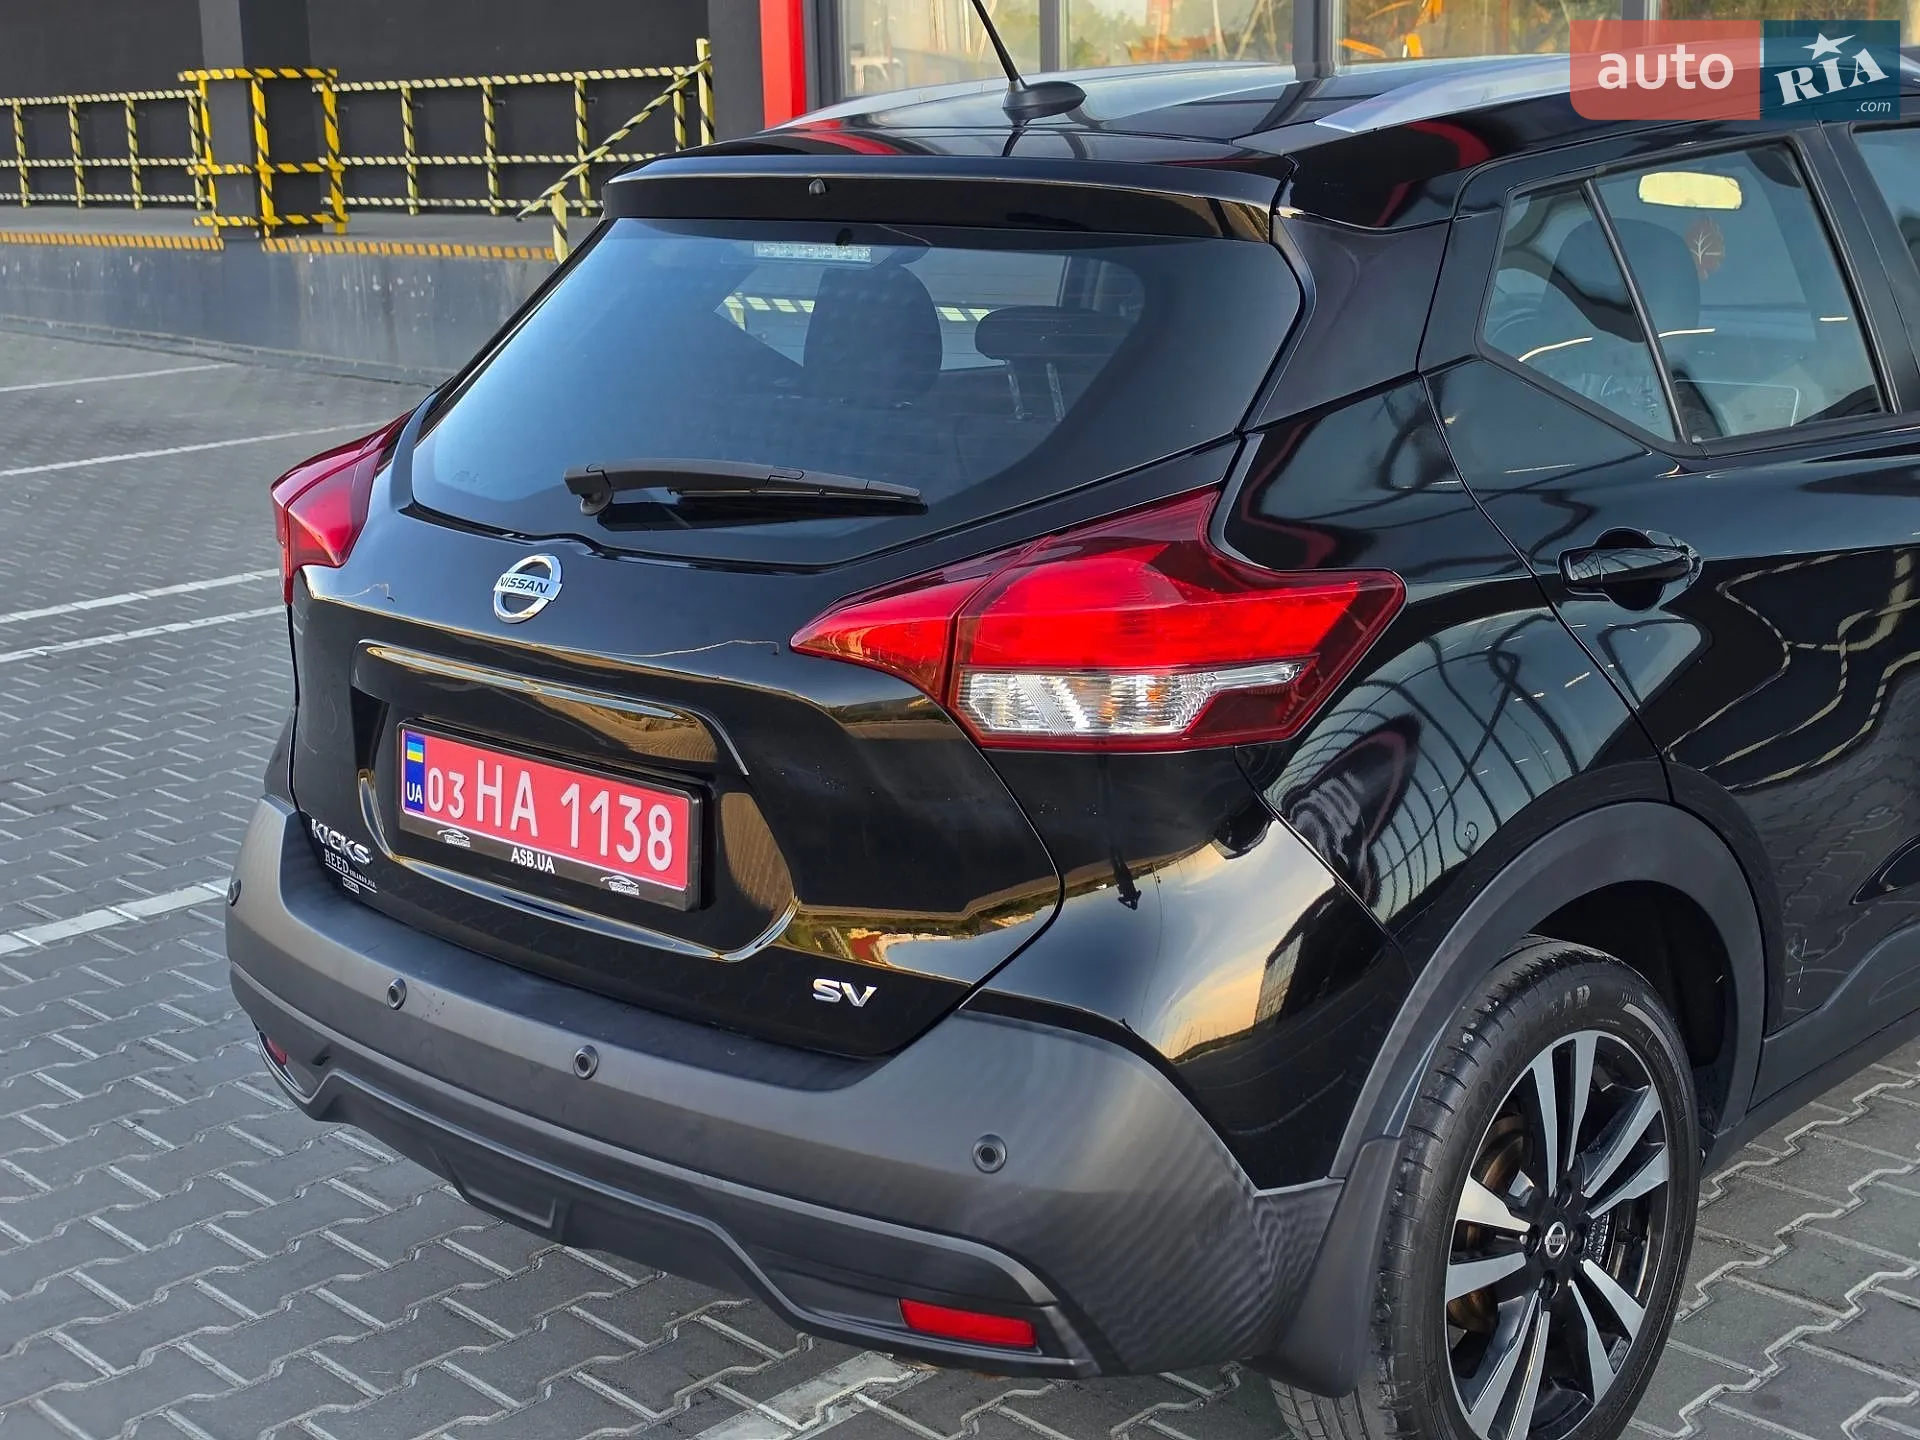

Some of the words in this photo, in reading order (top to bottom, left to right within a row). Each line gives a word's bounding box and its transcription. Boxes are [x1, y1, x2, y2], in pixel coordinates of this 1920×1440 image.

[500, 576, 549, 594] NISSAN
[407, 781, 423, 805] UA
[311, 818, 371, 865] KICKS
[560, 783, 673, 872] 1138
[510, 846, 556, 875] ASB.UA
[812, 978, 878, 1008] SV
